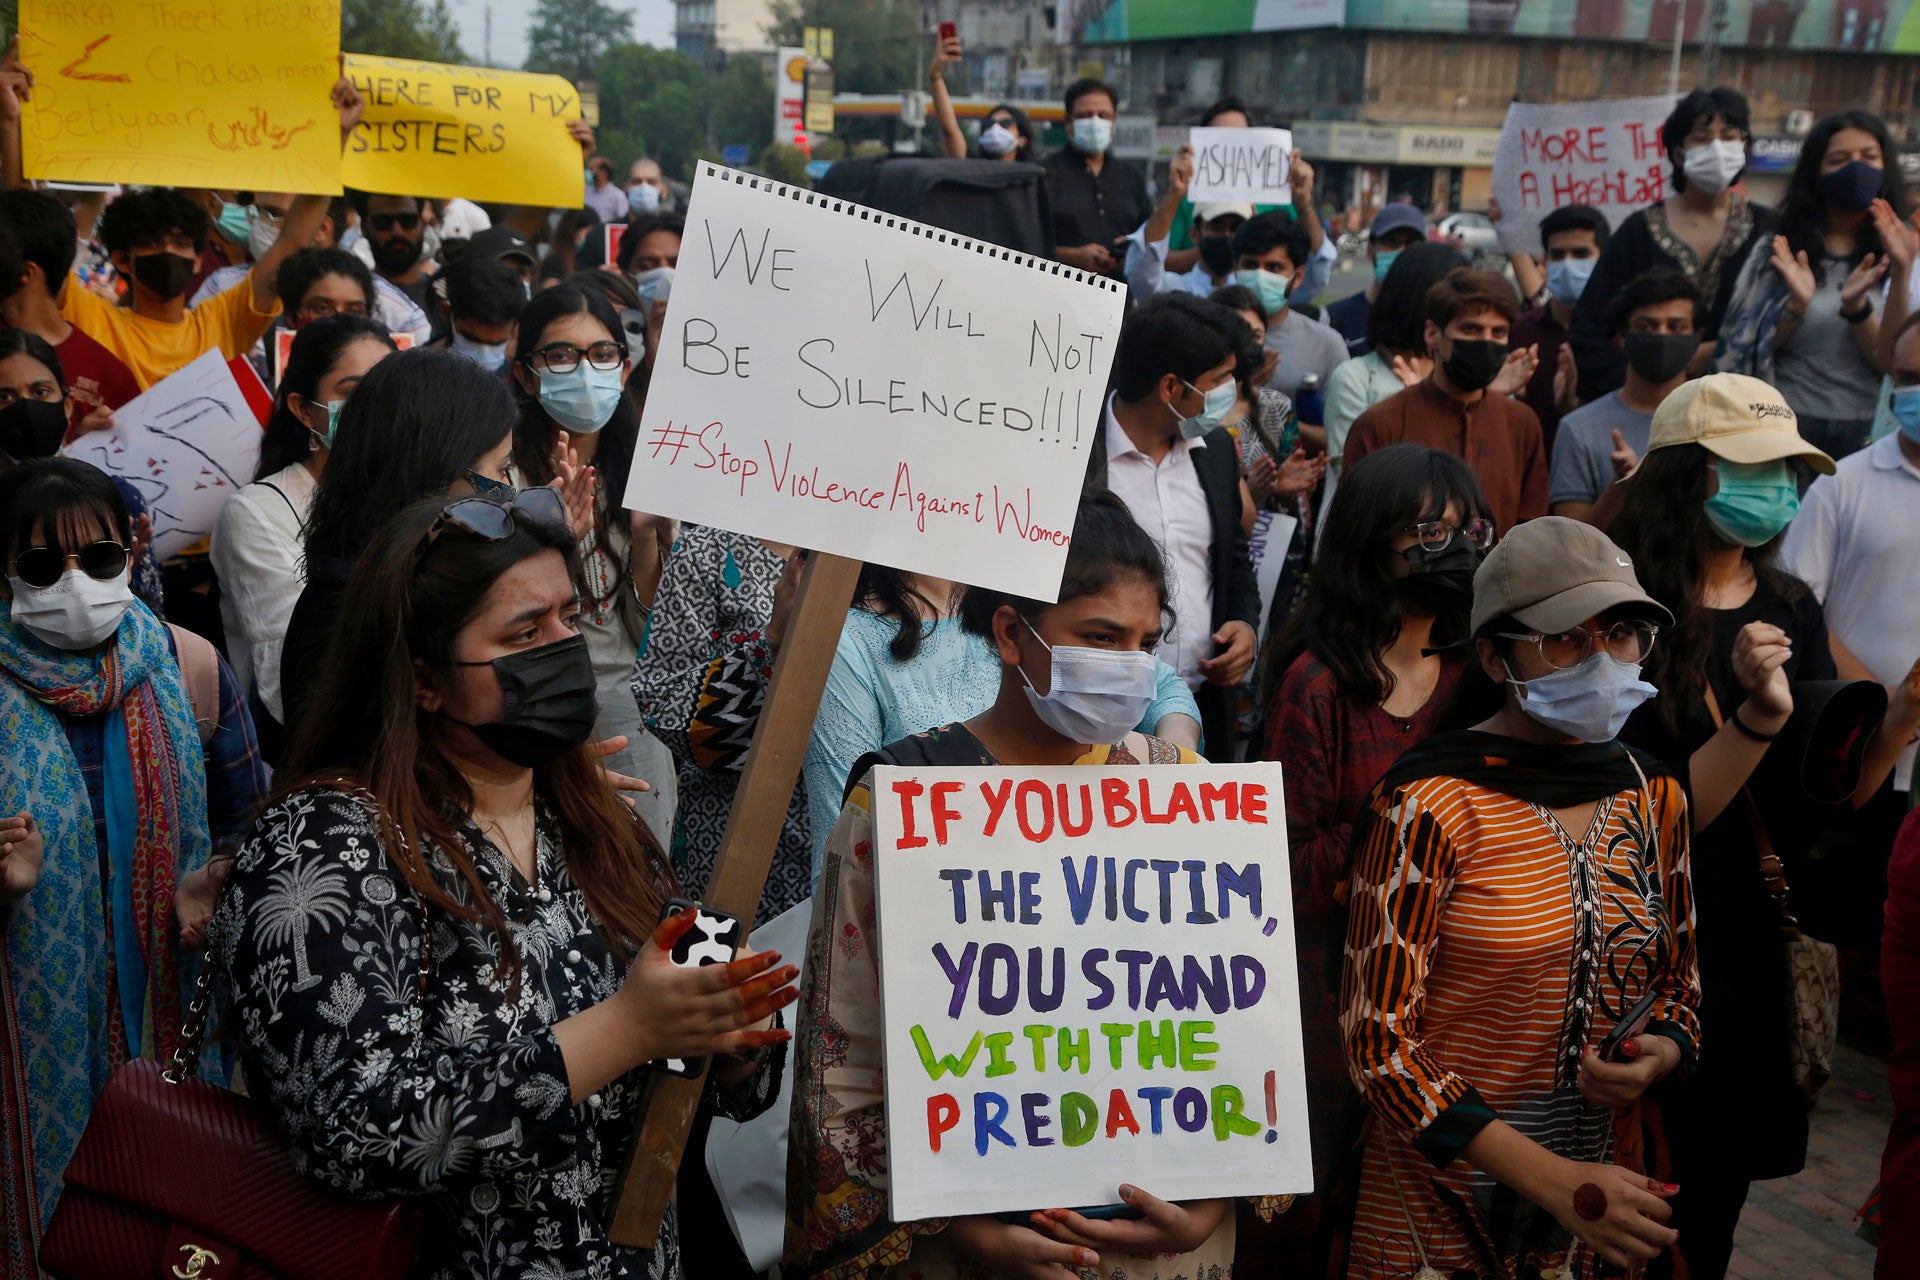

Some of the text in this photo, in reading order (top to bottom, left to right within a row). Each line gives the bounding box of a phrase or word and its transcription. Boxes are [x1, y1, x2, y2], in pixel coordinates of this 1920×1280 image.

[352, 75, 575, 117] HERE FOR MY
[351, 120, 506, 155] SISTERS
[1194, 143, 1291, 190] ASHAMED
[1520, 126, 1608, 165] MORE
[1519, 170, 1541, 209] A
[704, 218, 1104, 375] WE WILL NOT
[683, 317, 1082, 450] BE SILENCED!!!
[892, 778, 1269, 850] IF YOU BLAME
[939, 855, 1279, 937] THE VICTIM,
[932, 941, 1267, 1020] YOU STAND
[909, 1019, 1220, 1082] WITH THE
[926, 1069, 1280, 1157] PREDATOR!
